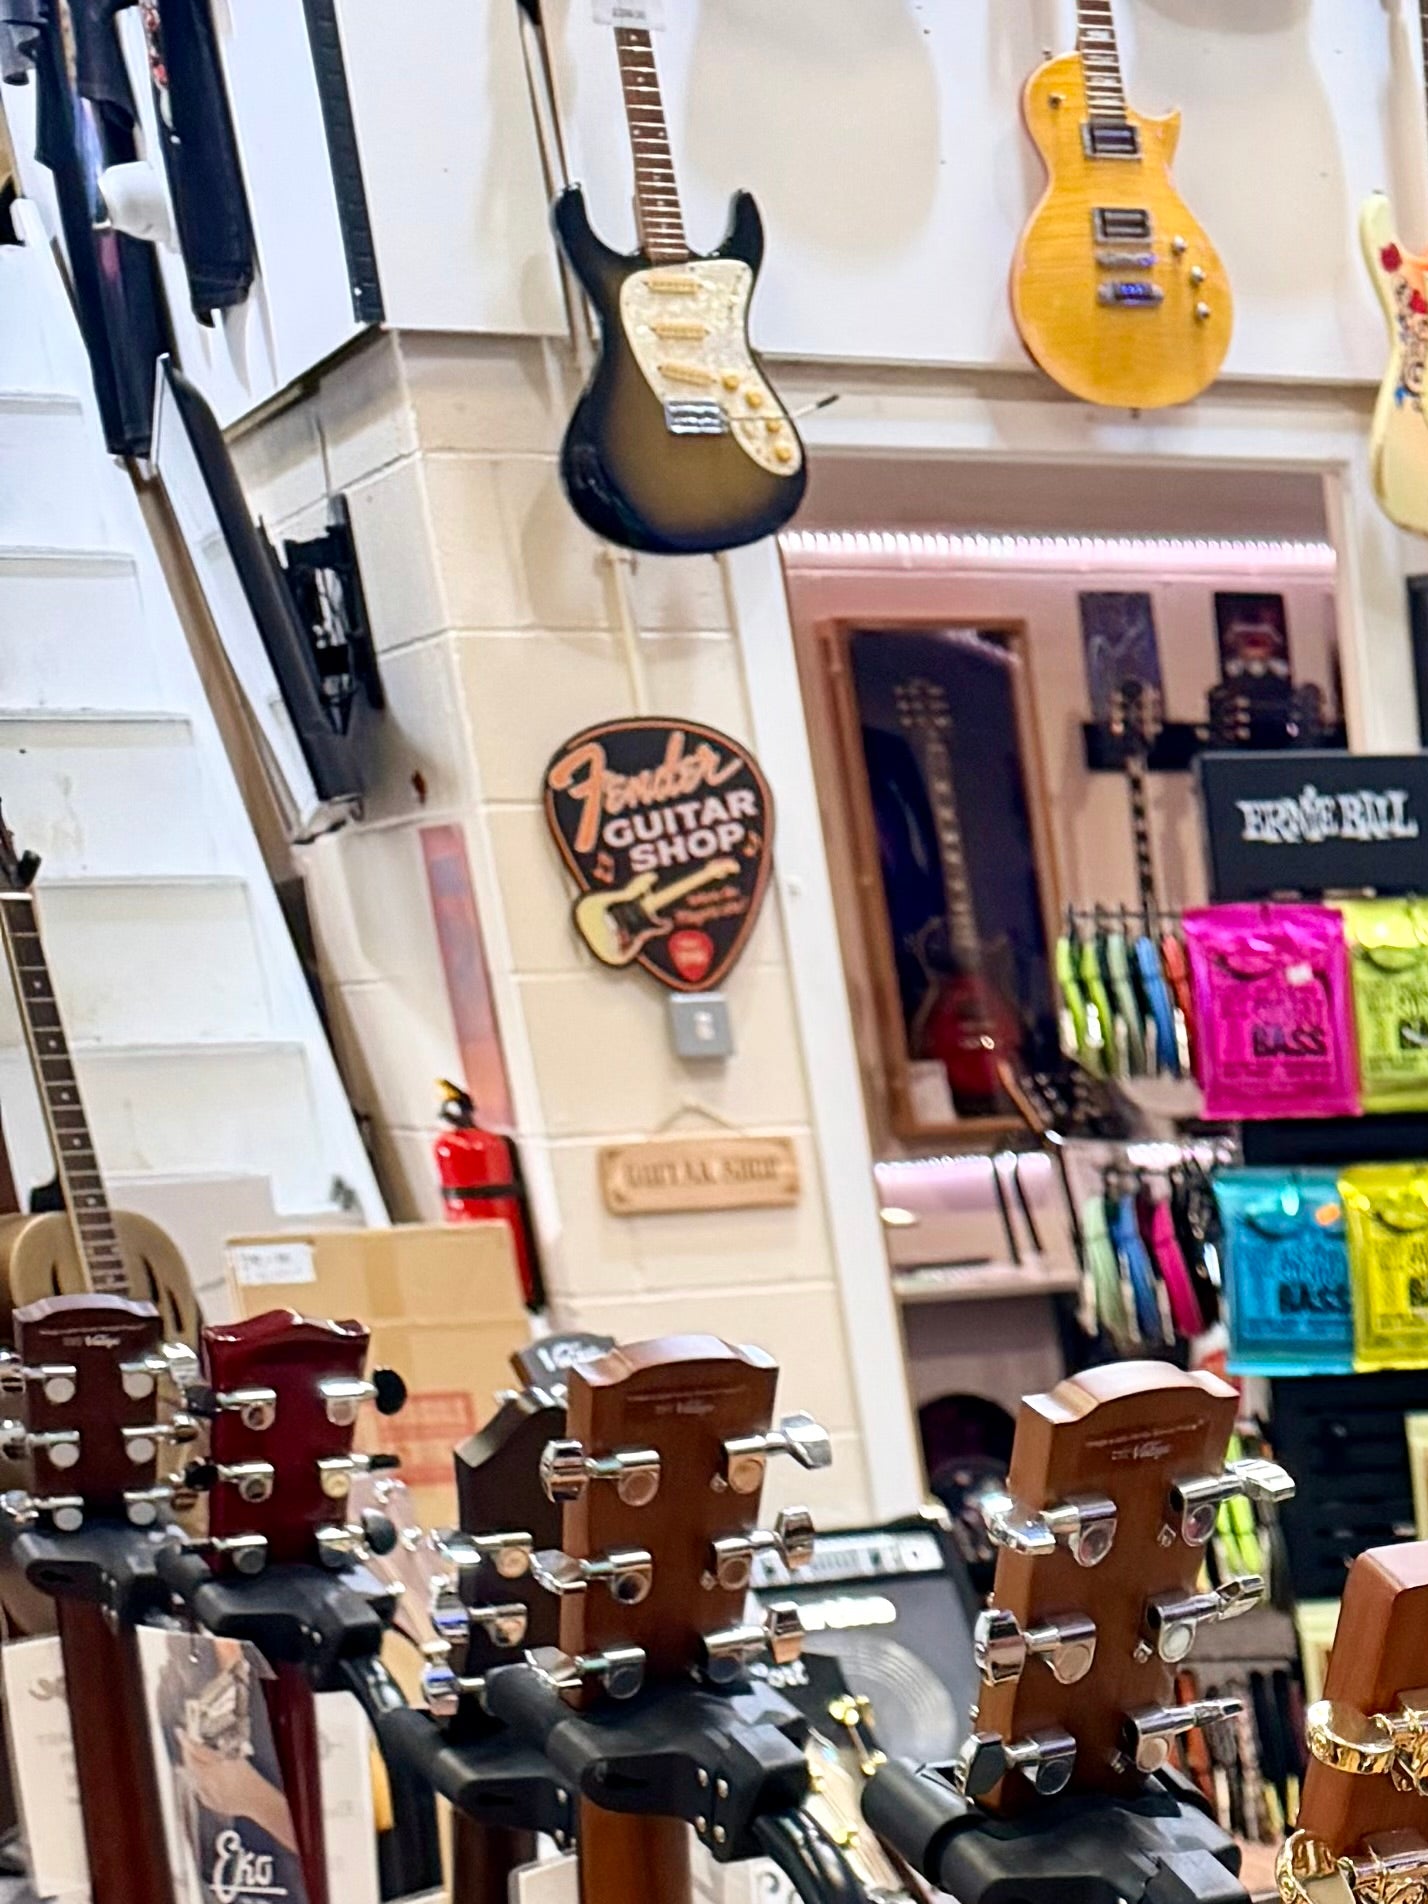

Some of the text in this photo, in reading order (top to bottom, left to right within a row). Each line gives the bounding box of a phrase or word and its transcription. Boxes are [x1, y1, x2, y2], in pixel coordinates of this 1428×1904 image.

[549, 730, 745, 853] Fender
[602, 788, 759, 849] GUITAR
[1235, 784, 1420, 845] ERNIE BALL
[629, 821, 746, 873] SHOP
[1252, 1022, 1326, 1057] BASS
